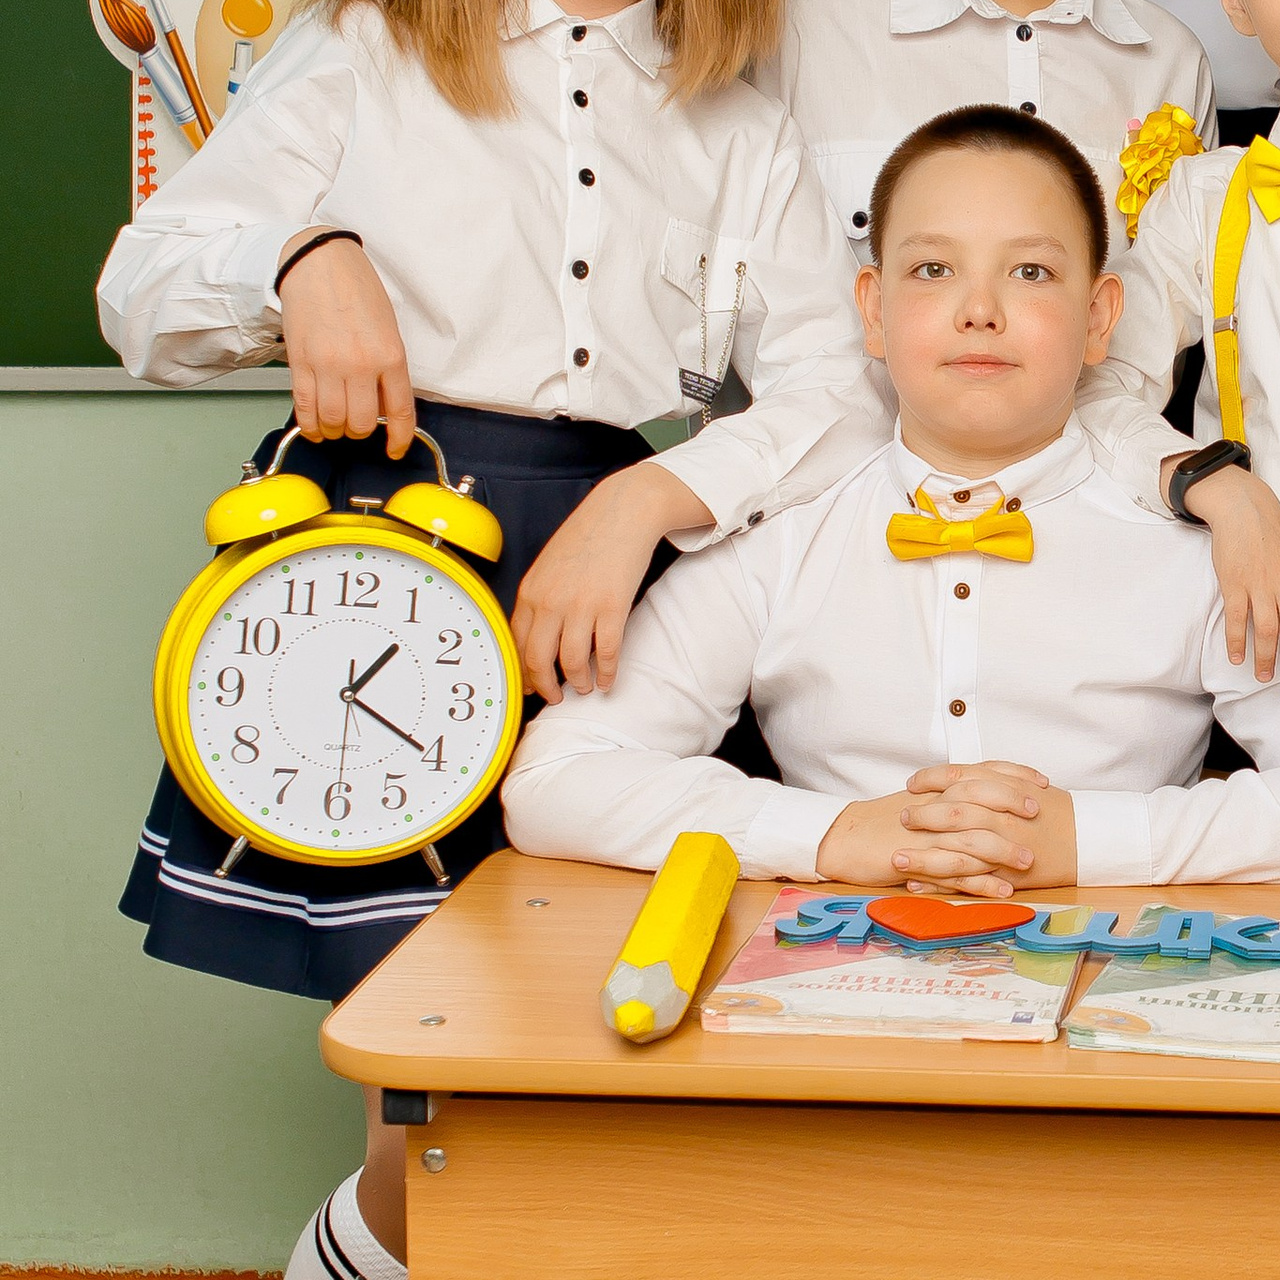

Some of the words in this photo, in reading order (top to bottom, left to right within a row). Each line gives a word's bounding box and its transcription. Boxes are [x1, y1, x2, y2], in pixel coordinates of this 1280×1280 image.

[280, 578, 319, 616] 11
[333, 570, 381, 609] 12
[403, 587, 421, 624] 1
[234, 617, 280, 656] 10
[435, 629, 463, 665] 2
[216, 666, 244, 707] 9
[448, 682, 475, 721] 3
[231, 725, 260, 764] 8
[323, 743, 361, 753] QUARTZ
[420, 735, 448, 772] 4
[272, 768, 299, 805] 7
[323, 781, 352, 820] 6
[381, 772, 407, 810] 5
[775, 896, 884, 946] Я
